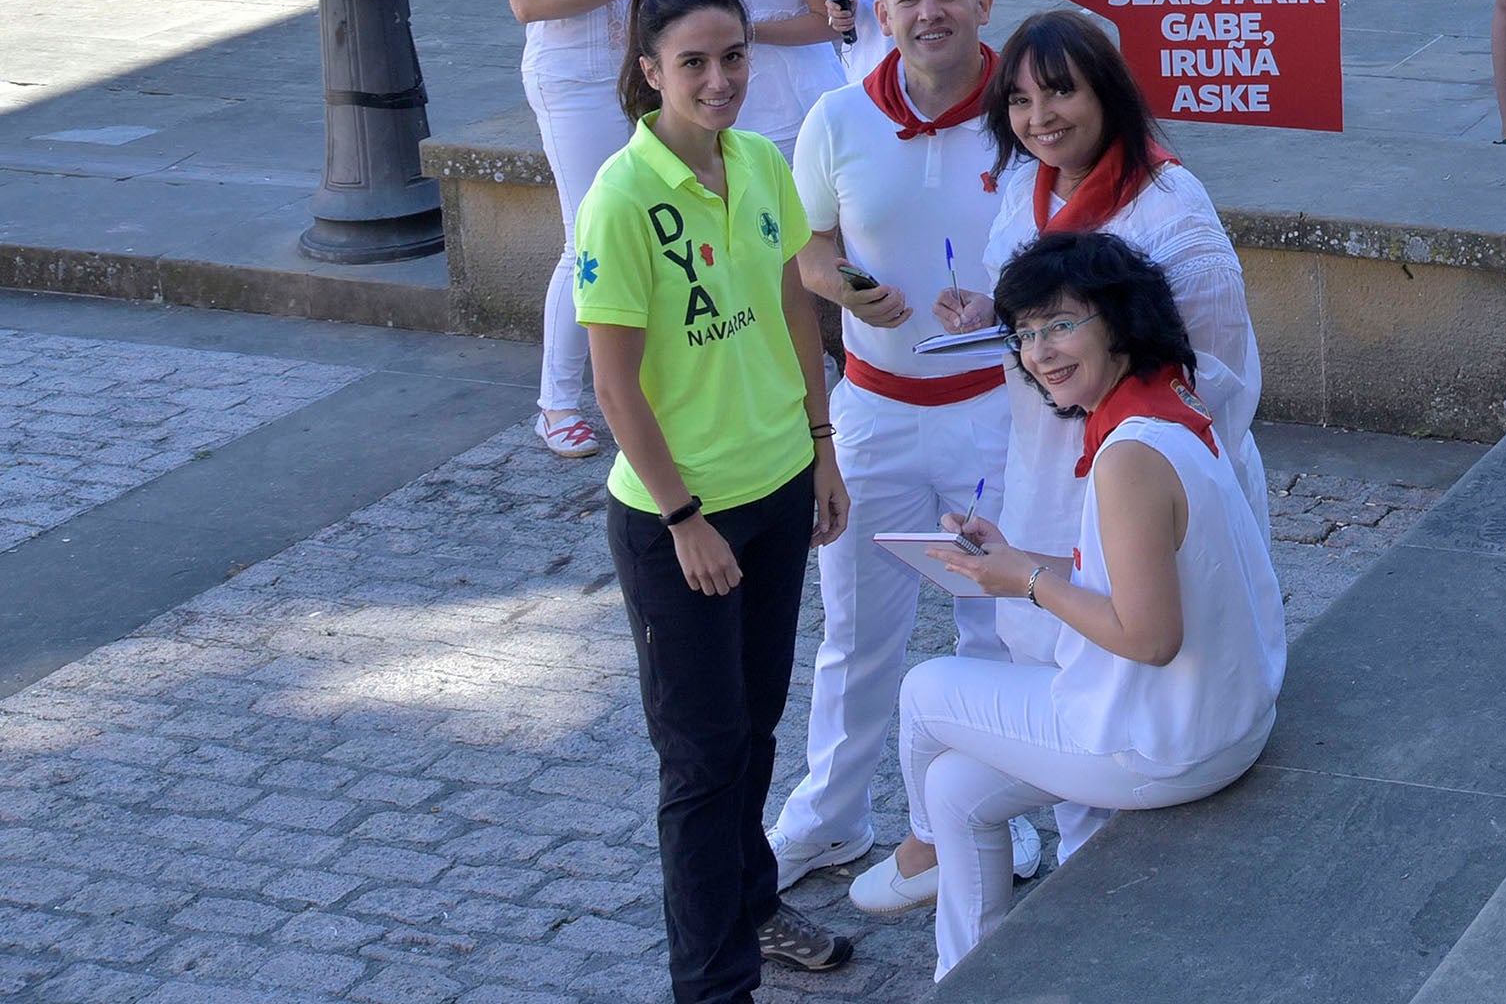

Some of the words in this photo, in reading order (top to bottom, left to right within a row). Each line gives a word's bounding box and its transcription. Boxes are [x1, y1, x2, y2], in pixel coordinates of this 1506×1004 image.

[1161, 13, 1275, 46] GABE,
[1160, 41, 1280, 77] IRUÑA
[1171, 84, 1271, 113] ASKE
